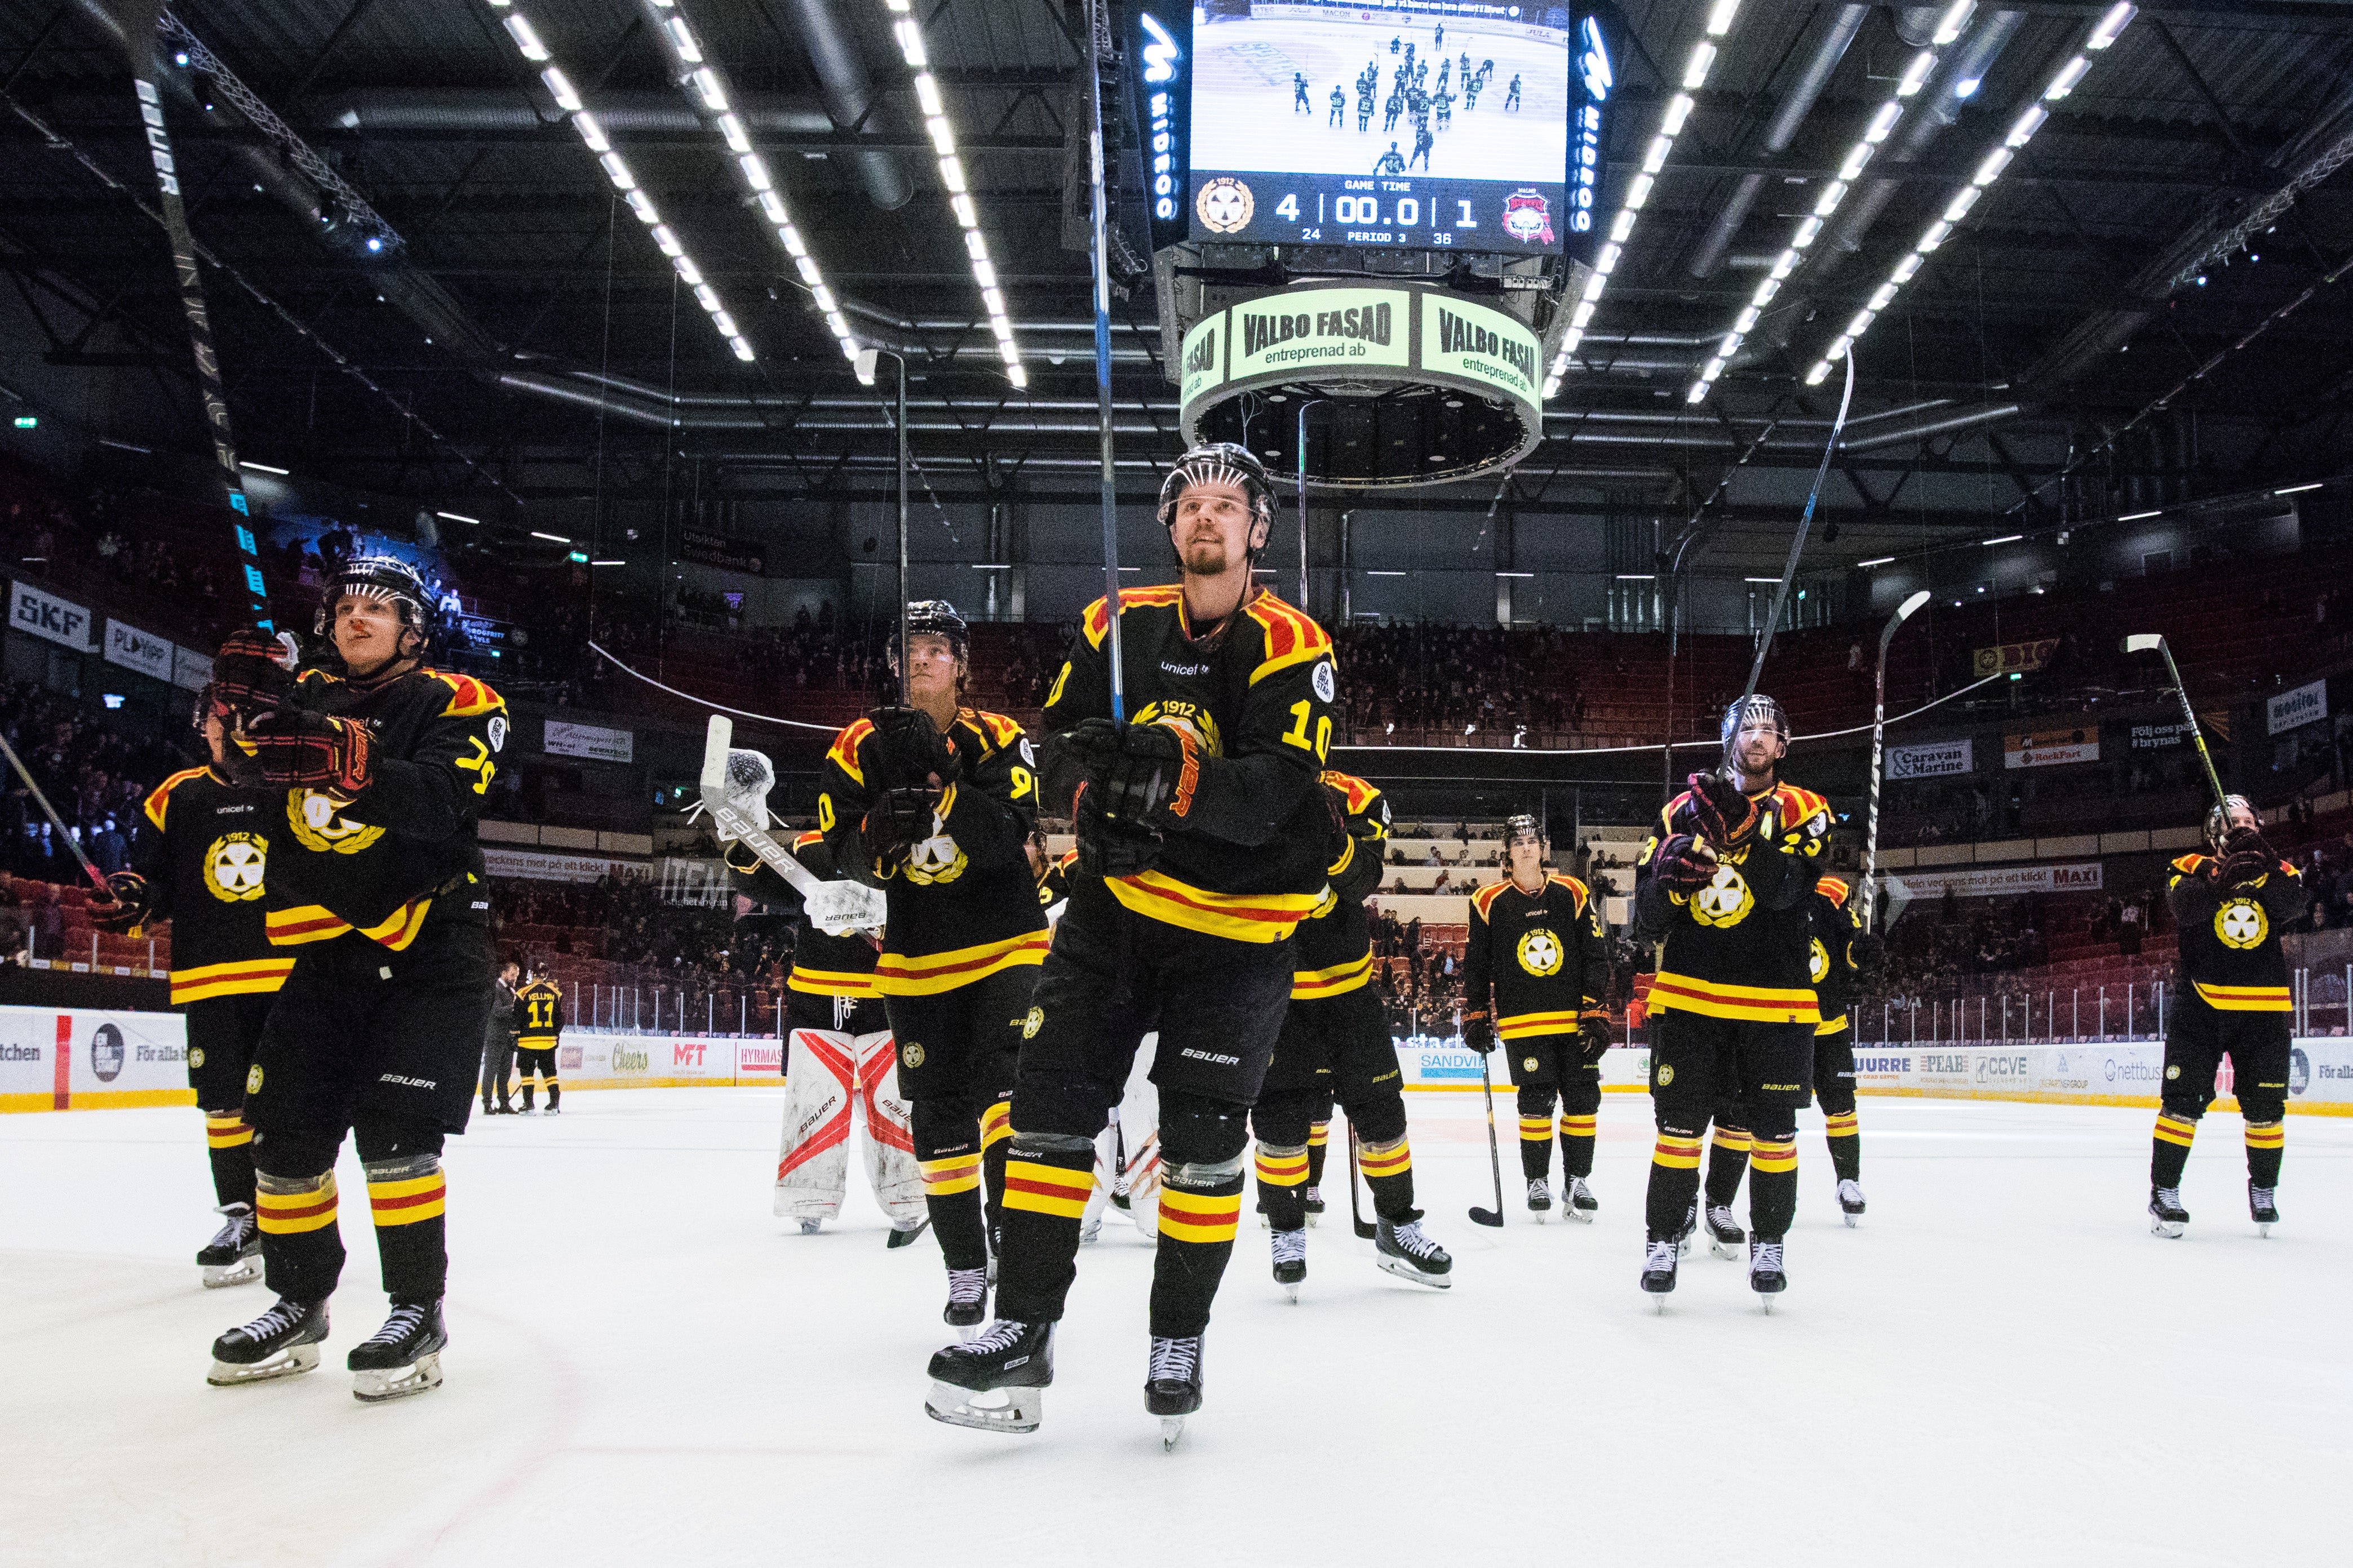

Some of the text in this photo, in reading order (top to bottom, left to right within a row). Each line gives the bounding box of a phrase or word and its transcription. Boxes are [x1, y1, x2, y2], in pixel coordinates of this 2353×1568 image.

[1322, 9, 1351, 17] MACON
[1151, 92, 1173, 219] MIDROC
[1576, 105, 1600, 232] MIDROC
[1345, 180, 1411, 192] GAME TIME
[1275, 194, 1300, 222] 4
[1456, 199, 1478, 228] 1
[1301, 228, 1452, 245] 24 PERIOD 3 36
[1243, 301, 1392, 358] VALBO FASAD
[1439, 307, 1499, 357] VALBO
[1265, 342, 1366, 363] entreprenad ab
[1463, 358, 1518, 387] entreprenad
[18, 593, 82, 636] SKF
[1160, 661, 1198, 676] unicef
[1320, 664, 1328, 677] EN
[1318, 673, 1329, 687] BRA
[1162, 700, 1196, 717] 1912
[1282, 699, 1332, 766] 10
[2132, 724, 2153, 738] Följ
[2155, 723, 2174, 734] oss
[1903, 750, 1962, 764] Caravan
[2035, 750, 2081, 762] RockPart
[1913, 761, 1964, 774] Marine
[216, 804, 245, 815] unicef
[225, 832, 250, 842] 1912
[715, 806, 795, 874] BAUER
[526, 859, 547, 870] mat
[579, 860, 603, 873] klick!
[609, 863, 650, 882] MAXI
[1969, 875, 1988, 885] mat
[2020, 871, 2046, 882] klick!
[2053, 868, 2097, 884] MAXI
[1525, 909, 1543, 917] unicef
[528, 1001, 554, 1028] 11
[135, 1045, 154, 1061] För
[157, 1046, 179, 1061] alla
[613, 1043, 649, 1072] Cheers
[1181, 1048, 1240, 1065] BAUER
[1926, 1055, 1964, 1073] PEAB
[1988, 1056, 2027, 1074] CCVE
[2319, 1064, 2334, 1079] För
[379, 1073, 437, 1090] BAUER
[1372, 1069, 1399, 1083] BAUER
[799, 1096, 836, 1133] BAUER
[882, 1099, 912, 1123] BAUE
[1664, 1126, 1694, 1135] BAUER
[933, 1143, 969, 1154] BAUER
[1007, 1147, 1043, 1158] BAUER
[369, 1165, 410, 1176] BAUER
[1172, 1175, 1216, 1188] BAUER
